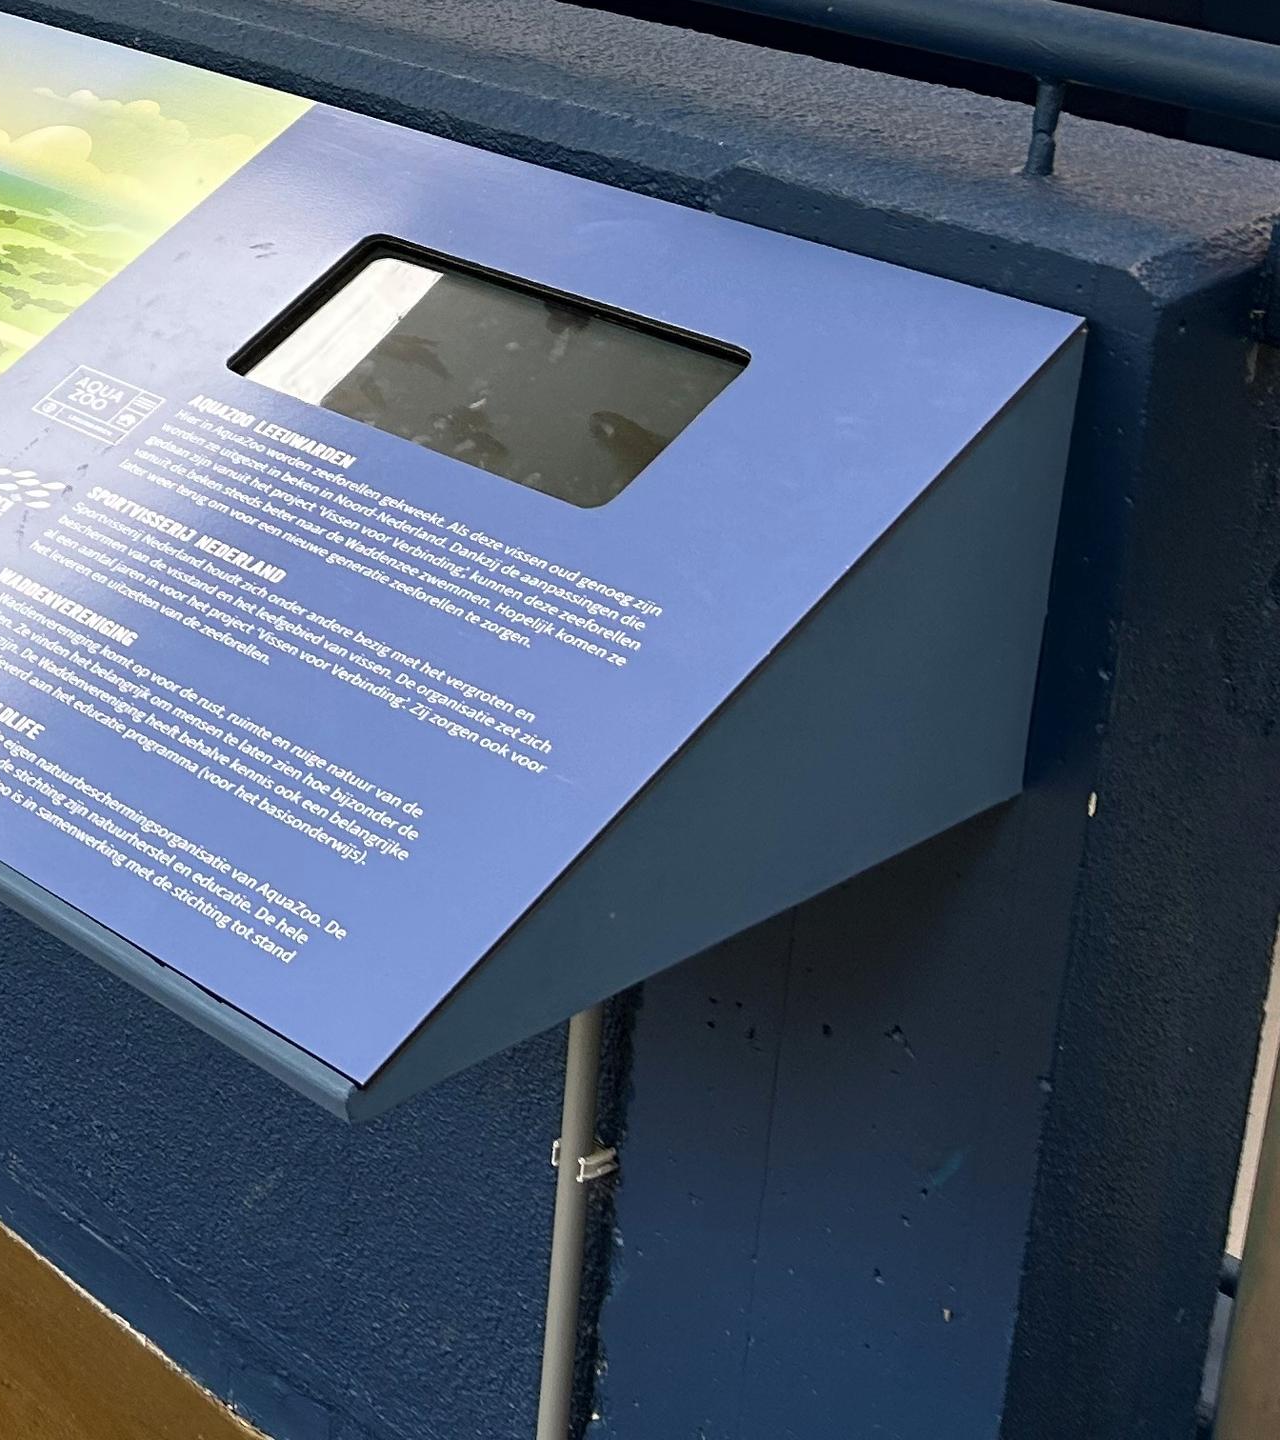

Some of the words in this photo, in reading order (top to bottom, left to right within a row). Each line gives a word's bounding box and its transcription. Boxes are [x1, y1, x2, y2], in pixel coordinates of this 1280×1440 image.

[67, 388, 108, 411] ZOO
[75, 376, 124, 403] AQUA
[187, 393, 257, 428] AQUAZOO
[252, 419, 357, 469] LEEUWARDEN
[86, 485, 198, 542] SPORTVISSERIJ
[193, 534, 288, 584] NEDERLAND
[221, 486, 264, 509] steeds
[261, 501, 297, 523] beter
[294, 518, 327, 536] naar
[324, 528, 345, 544] de
[342, 536, 420, 577] Waddenzee
[417, 571, 491, 609] zwemmen.
[493, 602, 559, 635] Hopelijk
[553, 627, 609, 659] komen
[605, 653, 628, 667] ze
[227, 508, 259, 526] voor
[256, 521, 284, 537] een
[280, 531, 330, 557] nieuwe
[324, 552, 391, 584] generatie
[388, 579, 465, 617] zeeforellen
[463, 610, 482, 624] te
[479, 619, 530, 648] zorgen.
[248, 476, 275, 493] het
[267, 488, 320, 512] project
[359, 525, 392, 544] voor
[468, 569, 524, 600] kunnen
[522, 592, 561, 616] deze
[557, 610, 643, 651] zeeforellen
[264, 447, 314, 472] worden
[311, 467, 383, 500] zeeforellen
[377, 495, 446, 527] gekweekt.
[446, 520, 471, 537] Als
[468, 528, 505, 551] deze
[502, 545, 549, 569] vissen
[547, 564, 583, 582] oud
[574, 576, 636, 608] genoeg
[631, 598, 663, 616] zijn
[266, 465, 283, 478] in
[279, 470, 321, 494] beken
[318, 487, 335, 500] in
[332, 493, 449, 548] Noord-Nederland.
[448, 541, 503, 573] Dankzij
[498, 562, 521, 579] de
[519, 573, 620, 620] aanpassingen
[618, 612, 647, 631] die
[143, 574, 161, 589] in
[157, 583, 188, 602] voor
[185, 594, 213, 613] het
[204, 607, 257, 634] project
[297, 650, 331, 671] voor
[408, 701, 433, 722] Zij
[427, 713, 480, 743] zorgen
[477, 737, 514, 757] ook
[507, 752, 546, 775] voor
[157, 604, 185, 621] van
[181, 613, 202, 630] de
[198, 624, 270, 665] zeeforellen.
[164, 566, 221, 595] visstand
[214, 590, 235, 603] en
[232, 595, 260, 614] het
[254, 605, 327, 645] leefgebied
[320, 640, 349, 657] van
[346, 652, 392, 680] vissen.
[393, 672, 417, 690] De
[414, 684, 497, 727] organisatie
[493, 721, 524, 739] zet
[518, 733, 556, 754] zich
[202, 560, 245, 586] houdt
[239, 581, 272, 598] zich
[266, 593, 307, 616] onder
[305, 611, 354, 638] andere
[352, 630, 392, 659] bezig
[389, 650, 424, 669] met
[418, 661, 449, 681] het
[443, 675, 515, 713] vergroten
[512, 708, 537, 723] en
[36, 656, 147, 724] Waddenvereniging
[143, 712, 183, 739] heeft
[177, 730, 231, 766] behalve
[228, 757, 276, 790] kennis
[272, 784, 307, 805] ook
[299, 798, 330, 819] een
[327, 810, 409, 862] belangrijke
[51, 685, 78, 705] het
[72, 699, 128, 733] educatie
[121, 727, 201, 773] programma
[195, 764, 236, 792] (voor
[233, 783, 263, 805] het
[257, 796, 369, 865] basisonderwijs).
[68, 650, 95, 669] het
[89, 661, 155, 700] belangrijk
[148, 695, 174, 712] om
[170, 706, 225, 739] mensen
[221, 731, 240, 747] te
[236, 738, 274, 765] laten
[271, 759, 303, 780] zien
[300, 772, 332, 795] hoe
[329, 786, 399, 831] bijzonder
[395, 821, 419, 842] de
[99, 644, 137, 668] komt
[130, 663, 153, 681] op
[148, 672, 182, 693] voor
[178, 684, 200, 702] de
[196, 696, 227, 719] rust,
[225, 712, 274, 741] ruimte
[270, 735, 292, 750] en
[289, 745, 328, 769] ruige
[325, 763, 376, 794] natuur
[372, 788, 403, 808] van
[400, 799, 424, 819] de
[1, 738, 39, 763] eigen
[34, 757, 232, 874] natuurbeschermingsorganisatie
[228, 868, 258, 889] van
[255, 881, 321, 928] AquaZoo.
[322, 920, 347, 941] De
[10, 789, 26, 804] is
[21, 795, 39, 811] in
[35, 806, 128, 868] samenwerking
[124, 859, 158, 881] met
[151, 871, 174, 892] de
[169, 885, 232, 930] stichting
[229, 918, 257, 940] tot
[250, 933, 297, 964] stand
[11, 767, 67, 807] stichting
[63, 798, 90, 817] zijn
[86, 811, 178, 867] natuurherstel
[171, 861, 193, 877] en
[189, 871, 251, 914] educatie.
[253, 906, 277, 926] De
[274, 917, 309, 945] hele
